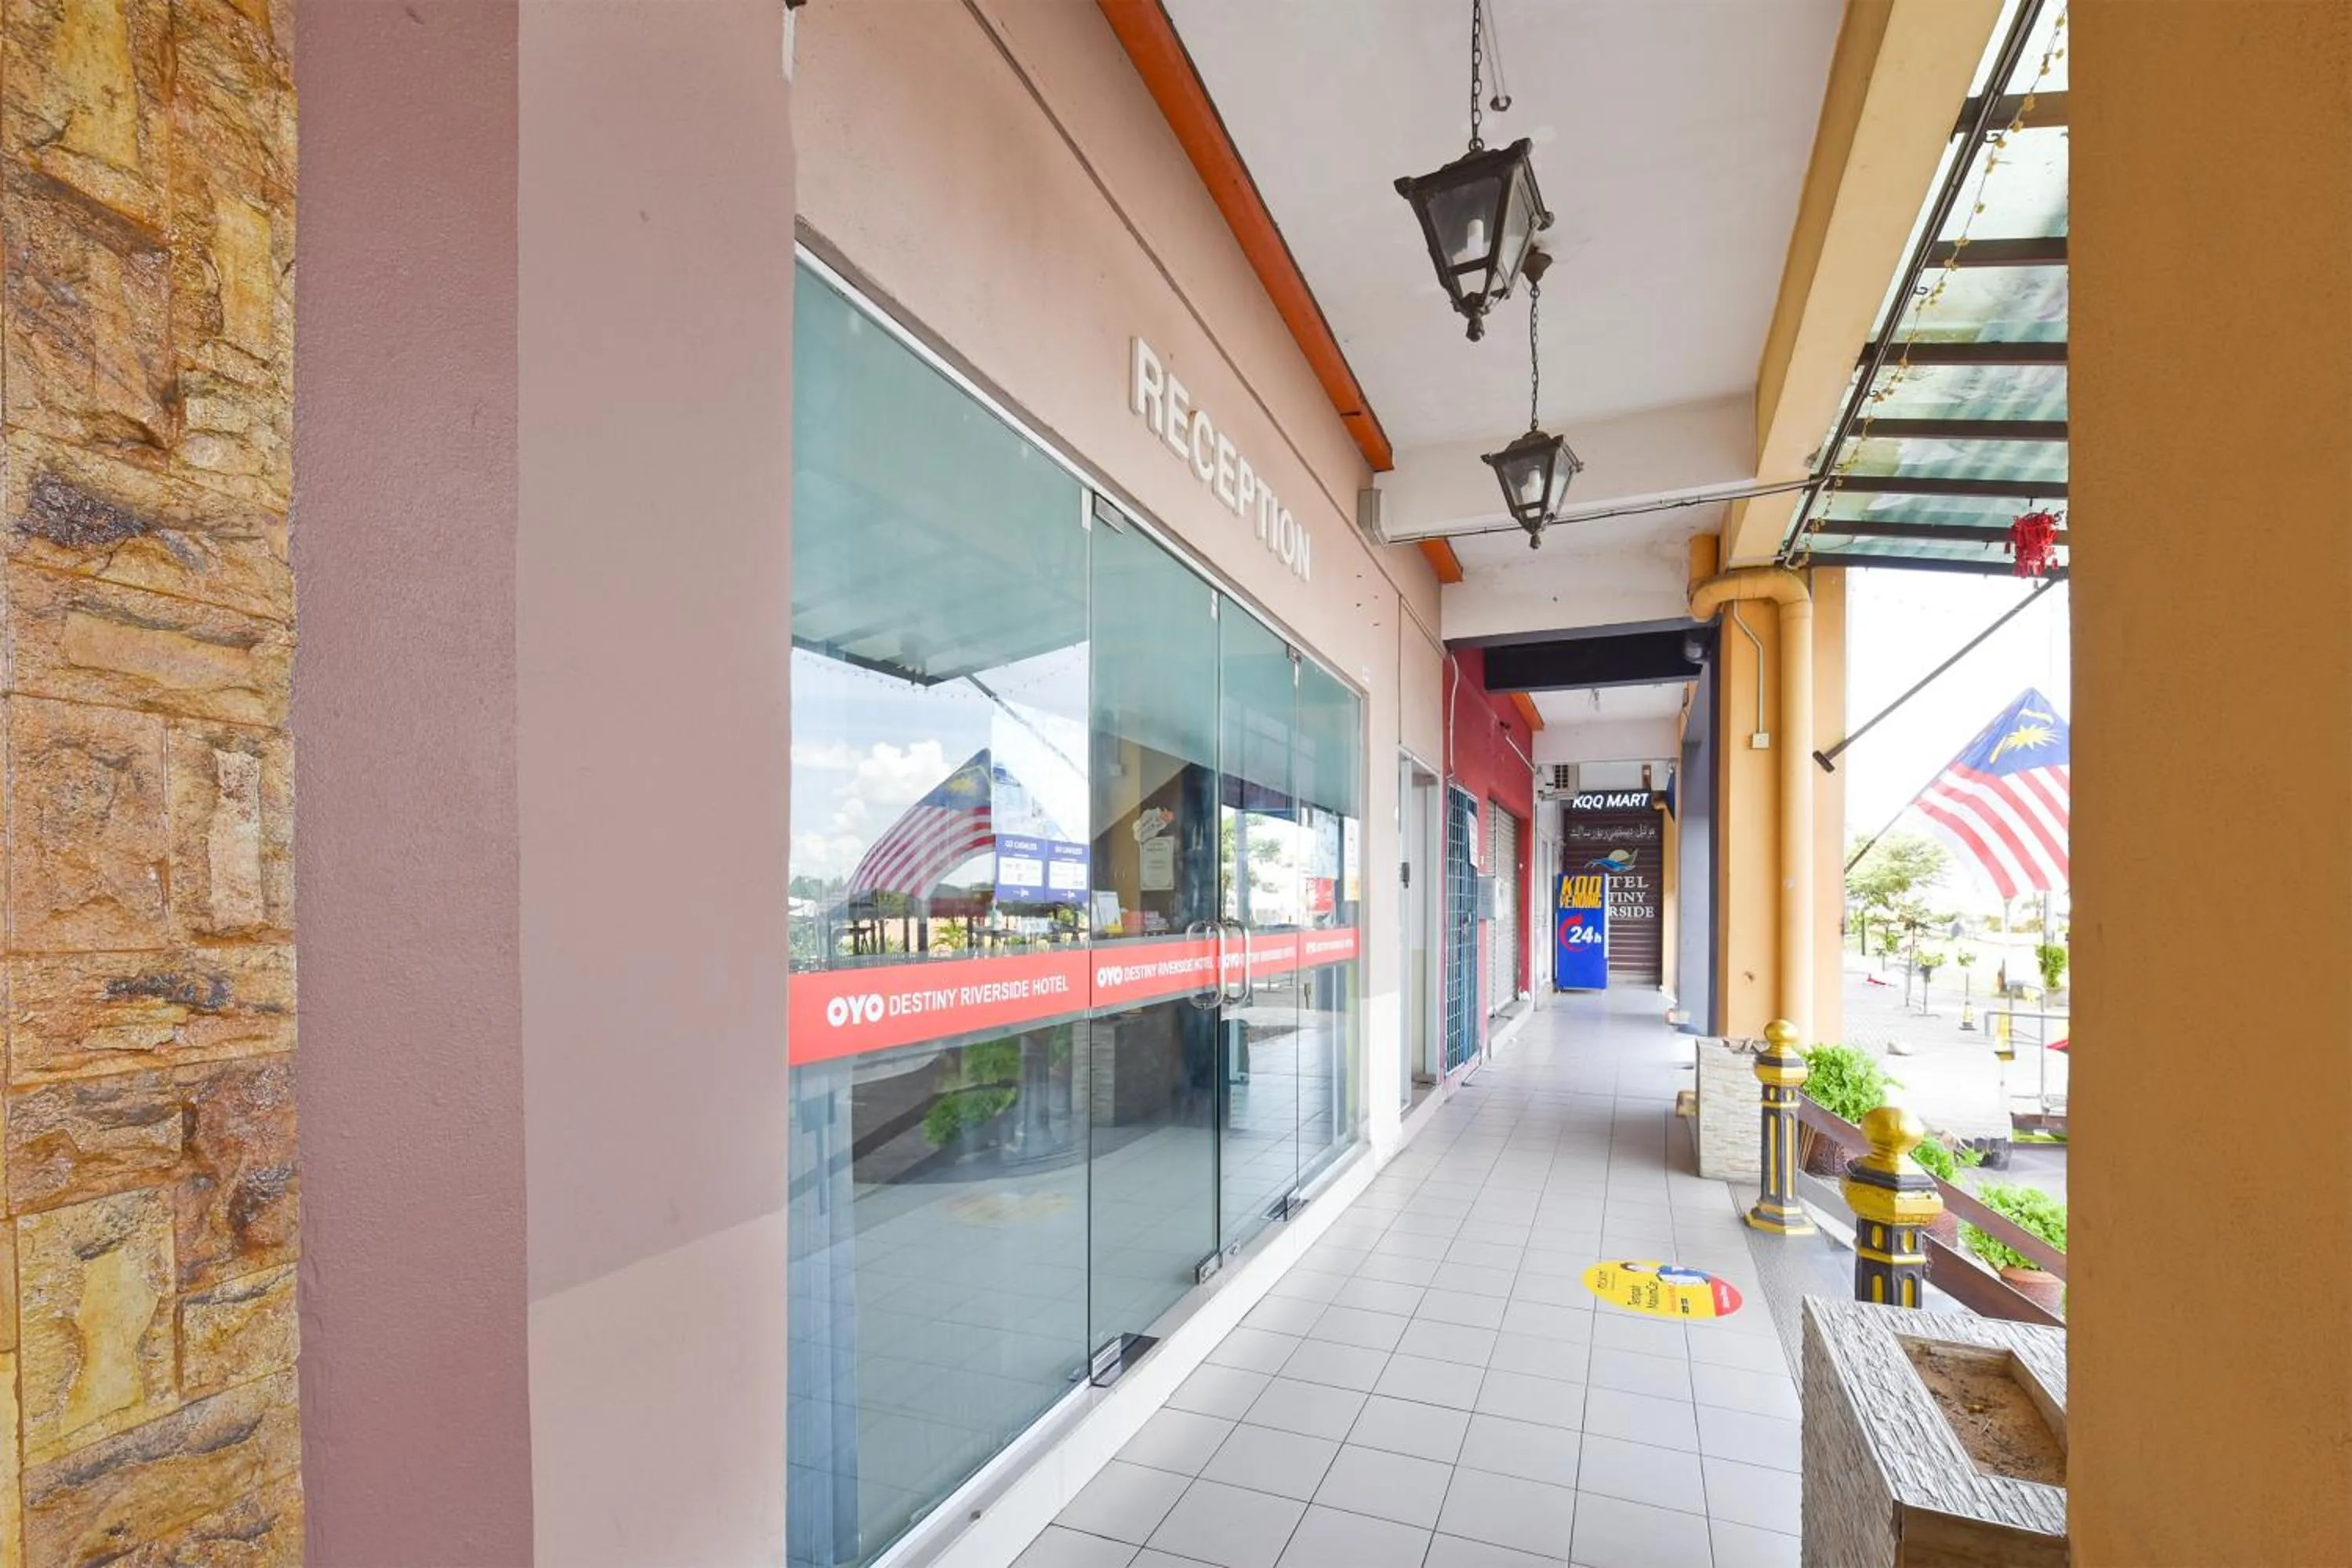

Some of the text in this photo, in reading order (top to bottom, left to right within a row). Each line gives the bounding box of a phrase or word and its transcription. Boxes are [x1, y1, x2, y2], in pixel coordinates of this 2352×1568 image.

[1129, 336, 1311, 583] RECEPTION
[1572, 793, 1649, 809] KQQ MART
[1609, 876, 1650, 888] TEL
[1609, 891, 1646, 902] TINY
[1609, 906, 1655, 917] RSIDE
[1568, 926, 1602, 943] 24h
[1098, 956, 1214, 987] OYO DESTINY RIVERSIDE HOTEL
[827, 975, 1069, 1027] OYO DESTINY RIVERSIDE HOTEL
